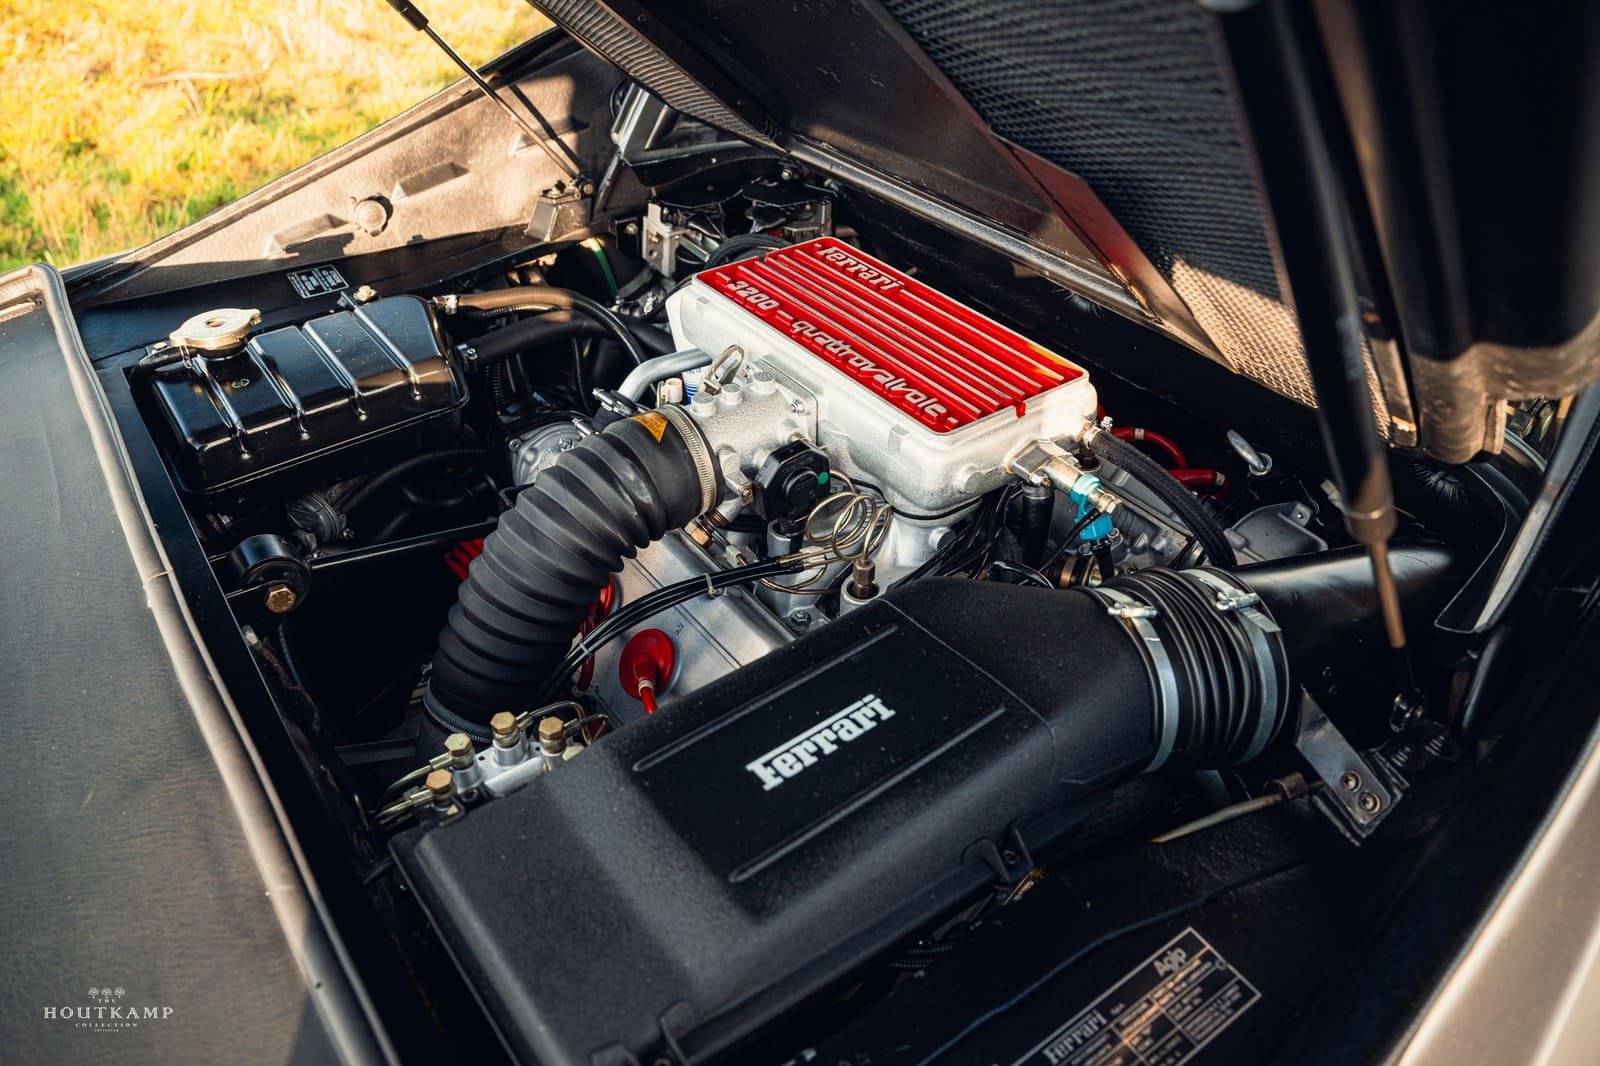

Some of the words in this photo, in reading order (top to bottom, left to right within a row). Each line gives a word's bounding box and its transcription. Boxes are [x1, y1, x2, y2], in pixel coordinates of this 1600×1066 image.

[816, 246, 905, 291] Ferrari
[726, 280, 780, 310] 3200
[791, 320, 948, 417] quattrovalvole
[745, 693, 896, 791] Ferrari
[1042, 1008, 1107, 1065] Ferrari
